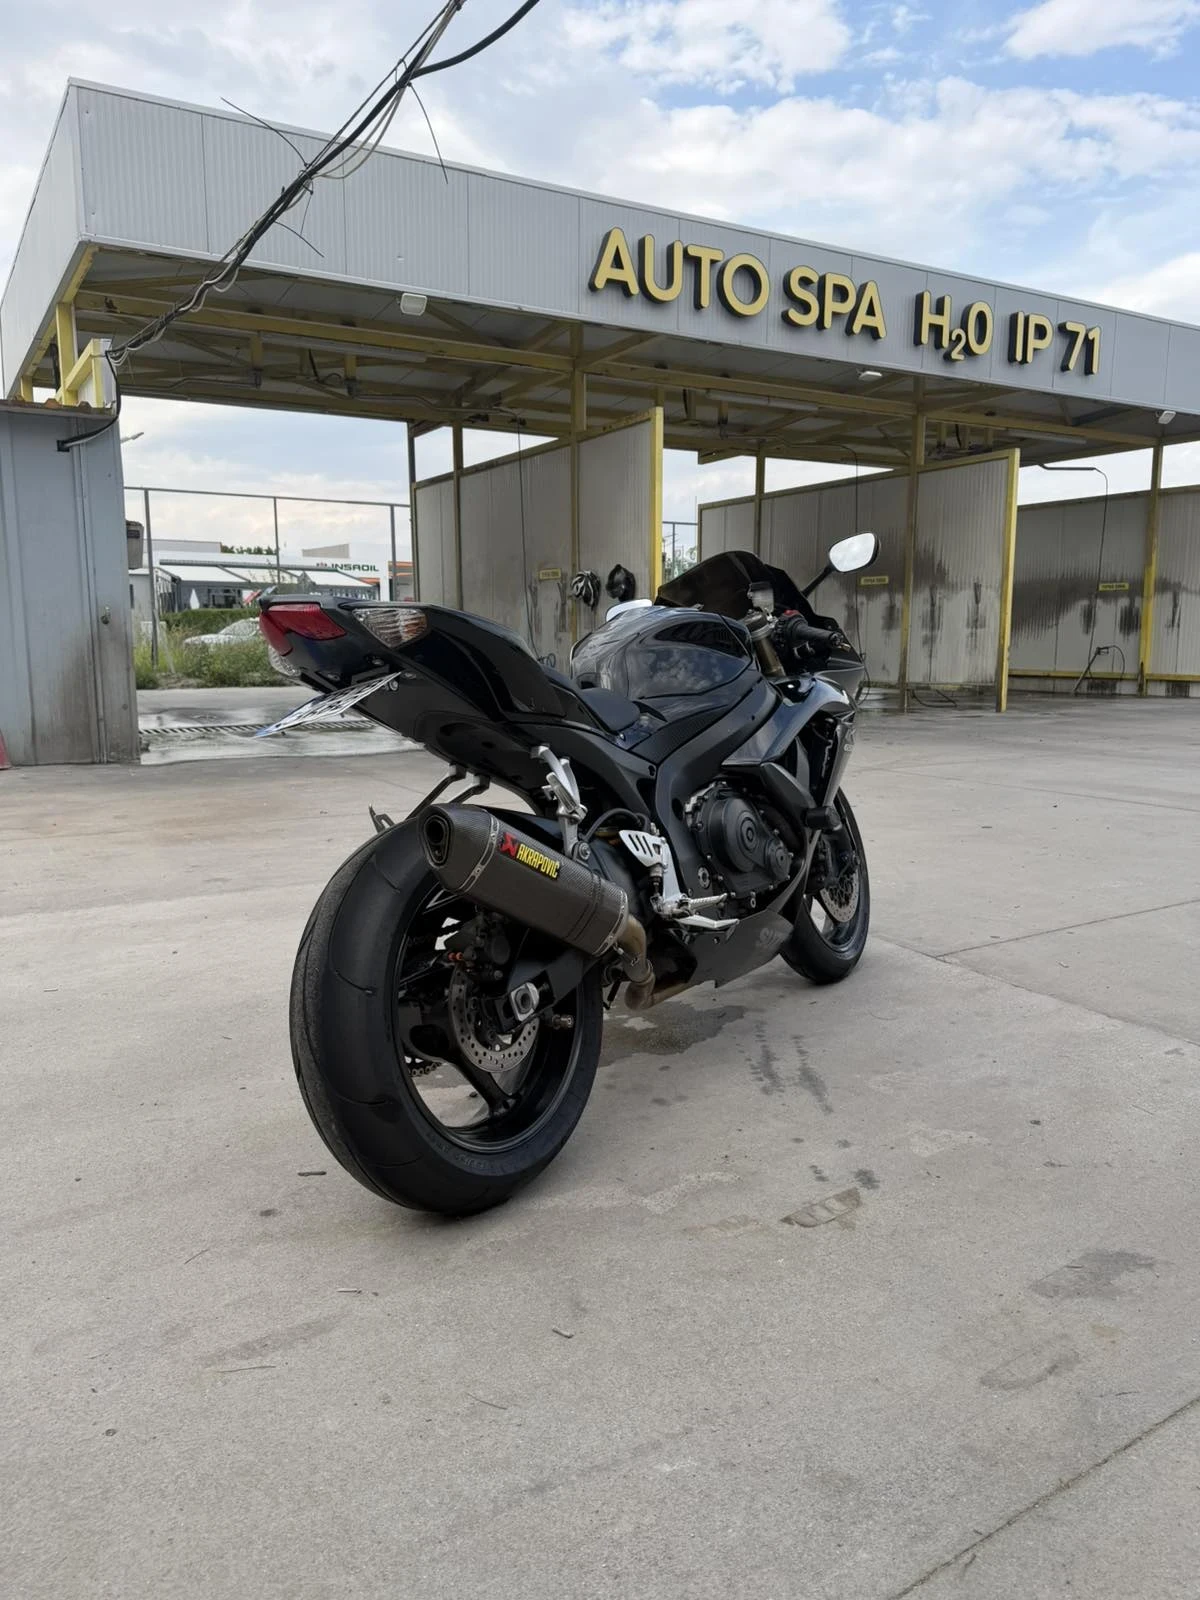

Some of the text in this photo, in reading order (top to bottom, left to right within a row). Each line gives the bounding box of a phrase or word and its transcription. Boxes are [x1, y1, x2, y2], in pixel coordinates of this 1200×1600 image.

[589, 227, 770, 317] AUTO
[781, 265, 887, 340] SPA
[1008, 311, 1054, 364] IP
[1058, 321, 1102, 376] 71
